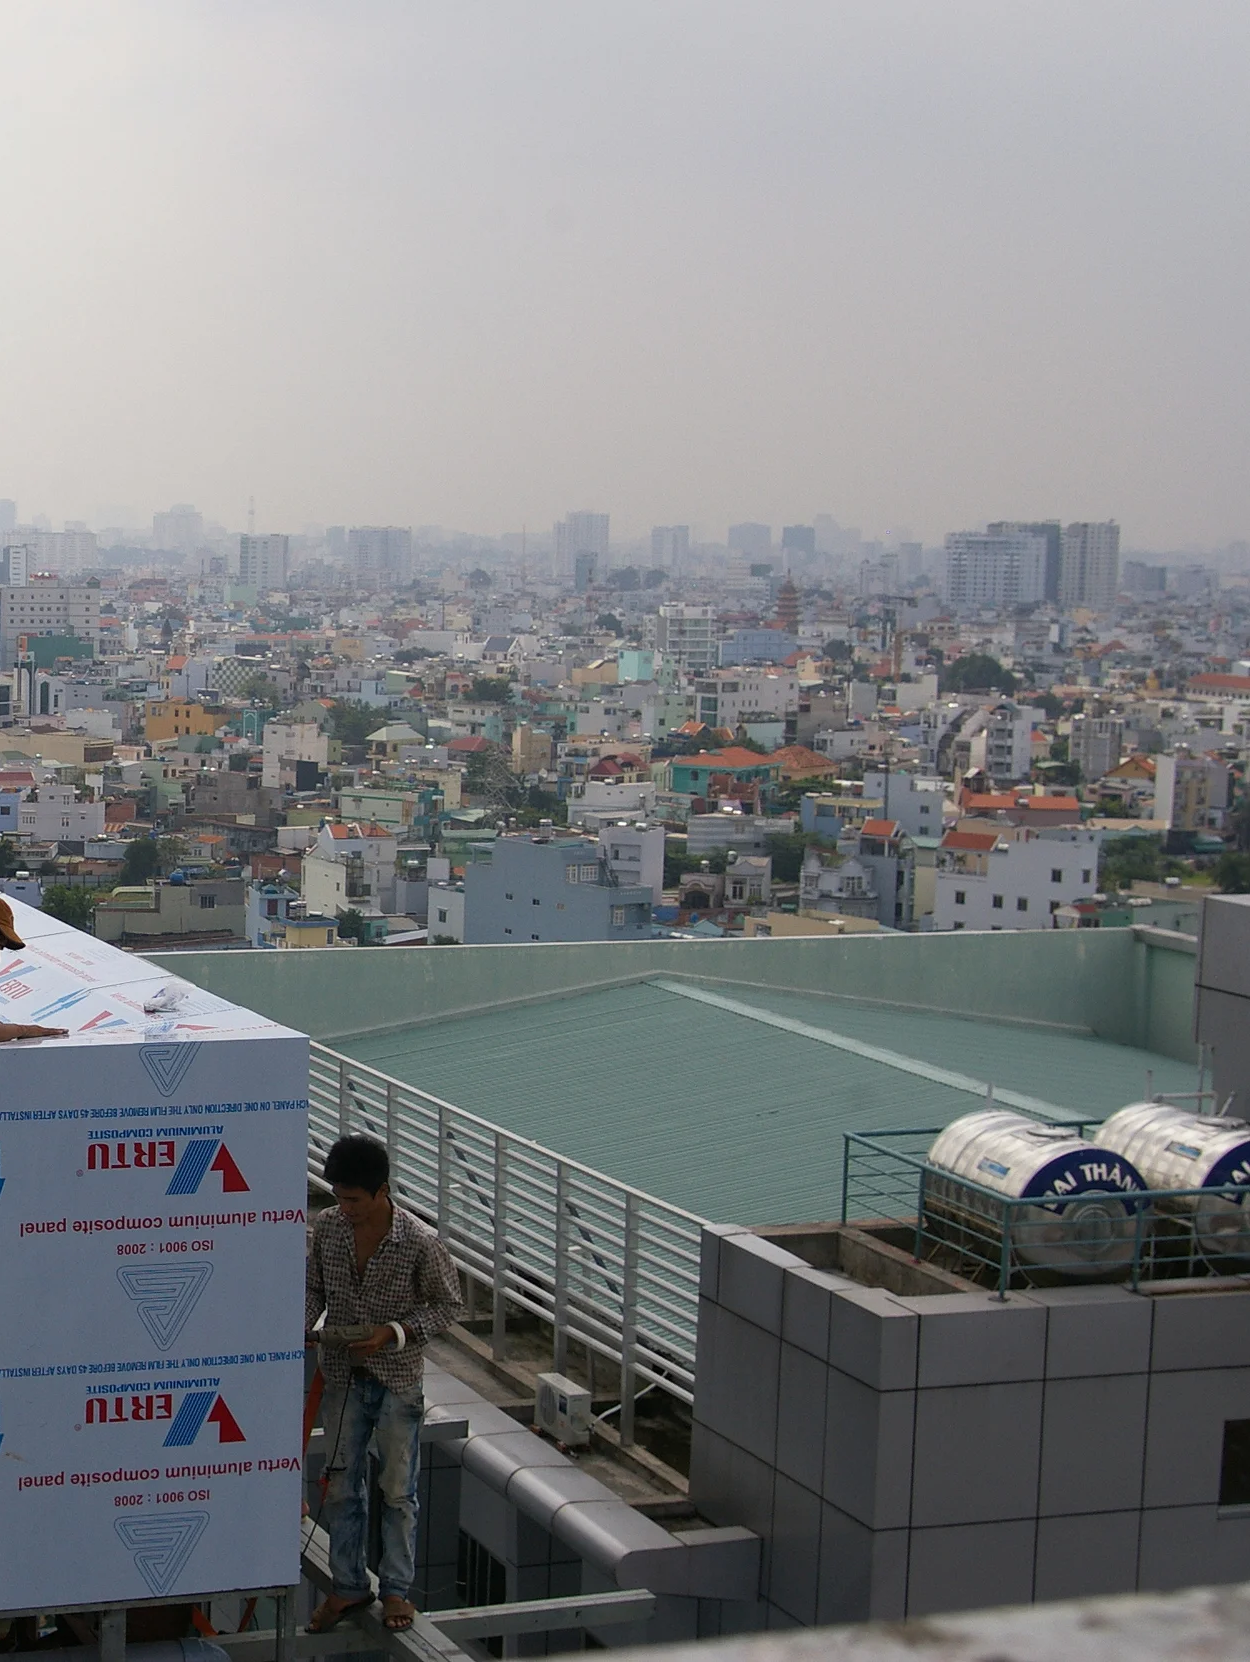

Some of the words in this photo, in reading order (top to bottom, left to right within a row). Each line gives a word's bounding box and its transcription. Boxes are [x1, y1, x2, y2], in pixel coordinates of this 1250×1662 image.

[150, 1106, 167, 1116] FILM
[168, 1105, 182, 1115] THE
[184, 1104, 203, 1114] ONLY
[205, 1103, 242, 1114] DIRECTION
[244, 1102, 258, 1112] ONE
[260, 1101, 271, 1111] ON
[273, 1100, 295, 1111] PANEL
[32, 1110, 56, 1120] AFTER
[59, 1109, 79, 1119] DAYS
[80, 1109, 90, 1118] 45
[90, 1108, 117, 1118] BEFORE
[119, 1107, 149, 1117] REMOVE
[88, 1128, 152, 1140] COMPOSITE
[156, 1125, 224, 1137] ALUMINIUM
[87, 1139, 250, 1195] VERTU
[1079, 1162, 1143, 1203] THÀN
[168, 1212, 256, 1229] aluminium
[262, 1209, 305, 1224] Vertu
[20, 1218, 67, 1237] panel
[72, 1216, 162, 1235] composite
[117, 1243, 146, 1255] 2008
[159, 1241, 188, 1254] 9001
[191, 1240, 214, 1253] ISO
[202, 1355, 239, 1367] DIRECTION
[240, 1354, 255, 1364] ONE
[256, 1353, 267, 1363] ON
[269, 1351, 291, 1361] PANEL
[89, 1363, 116, 1374] BEFORE
[117, 1361, 147, 1373] REMOVE
[148, 1360, 165, 1370] FILM
[166, 1359, 180, 1369] THE
[182, 1358, 201, 1368] ONLY
[32, 1366, 55, 1377] AFTER
[57, 1365, 77, 1376] DAYS
[78, 1365, 88, 1374] 45
[86, 1382, 150, 1395] COMPOSITE
[154, 1378, 221, 1391] ALUMINIUM
[85, 1391, 246, 1447] VERTU
[165, 1461, 252, 1480] aluminium
[258, 1458, 301, 1472] Vertu
[18, 1471, 65, 1491] panel
[70, 1468, 160, 1487] composite
[114, 1494, 143, 1507] 2008
[156, 1491, 184, 1504] 9001
[188, 1489, 210, 1502] ISO
